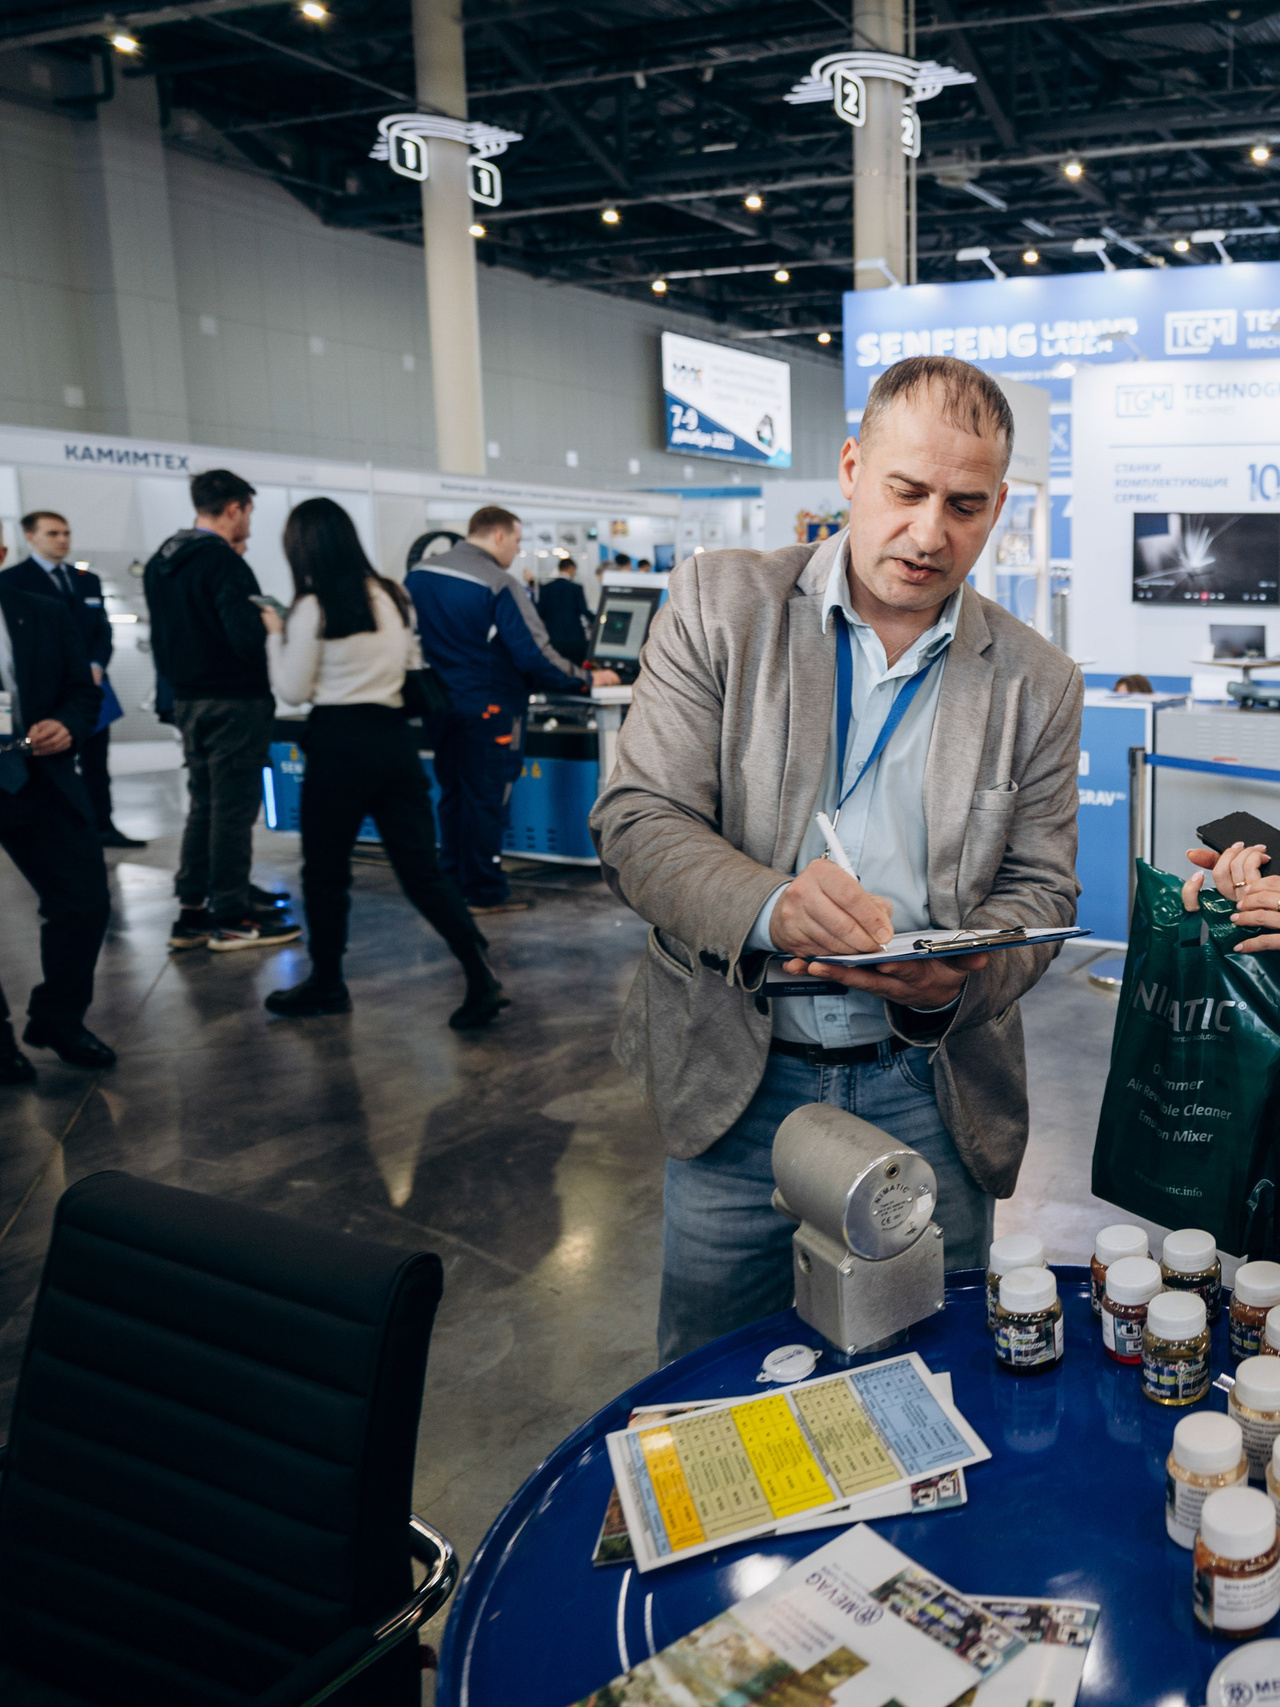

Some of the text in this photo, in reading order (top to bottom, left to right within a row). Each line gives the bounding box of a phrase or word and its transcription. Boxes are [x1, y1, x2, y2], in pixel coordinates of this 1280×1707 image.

[843, 82, 859, 115] 2
[901, 116, 914, 147] 2
[402, 140, 417, 170] 1
[478, 168, 491, 196] 1
[856, 322, 1037, 367] SENFENG
[1172, 317, 1229, 347] TGM
[64, 443, 190, 470] КАМИМТЕХ
[1114, 463, 1162, 474] СТАНКИ
[1114, 477, 1229, 490] КОМПЛЕКТУЮЩИЕ
[1114, 492, 1160, 504] СЕРВИС
[1126, 1078, 1143, 1093] Air
[1183, 1103, 1233, 1121] Cleaner
[1172, 1129, 1214, 1143] Mixer
[874, 1183, 910, 1204] NIMATIC
[805, 1572, 859, 1615] MEVAG
